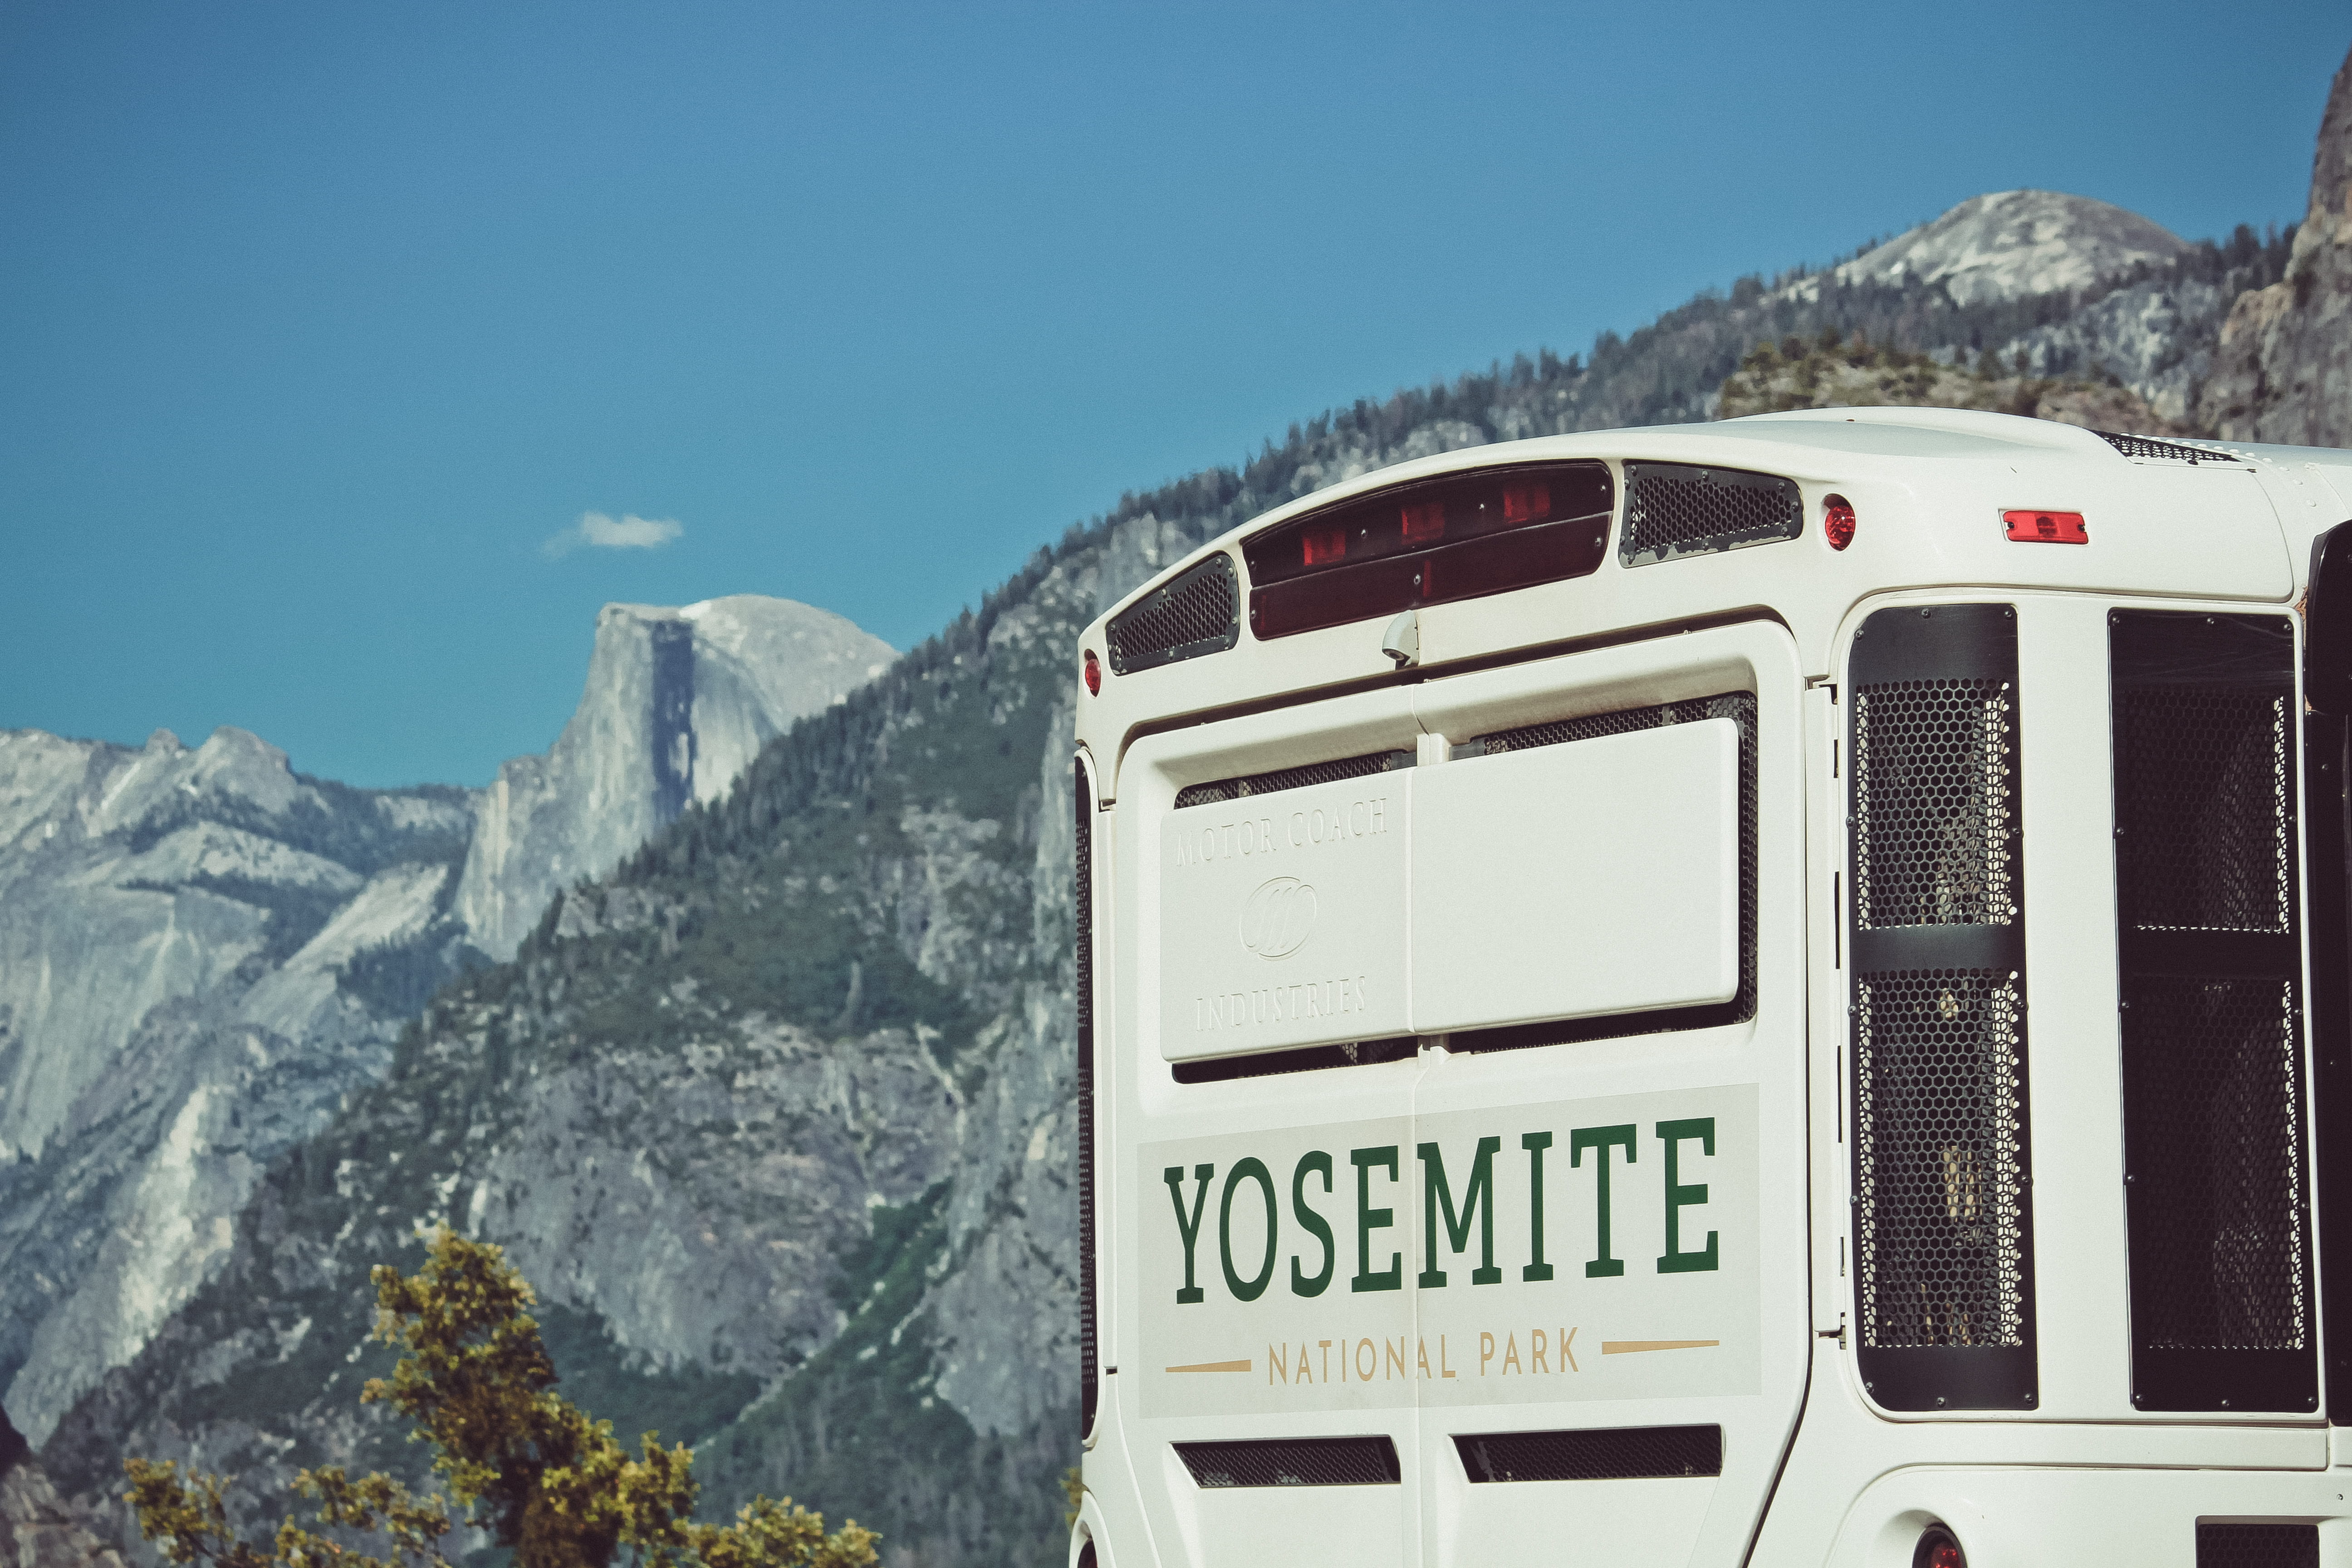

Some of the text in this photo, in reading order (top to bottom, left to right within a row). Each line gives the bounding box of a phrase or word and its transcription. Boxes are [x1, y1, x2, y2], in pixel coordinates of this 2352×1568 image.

[1176, 797, 1387, 867] MOTOR COACH
[1195, 975, 1366, 1032] INDUSTRIES
[1164, 1117, 1719, 1304] YOSEMITE
[1269, 1327, 1579, 1386] NATIONAL PARK
